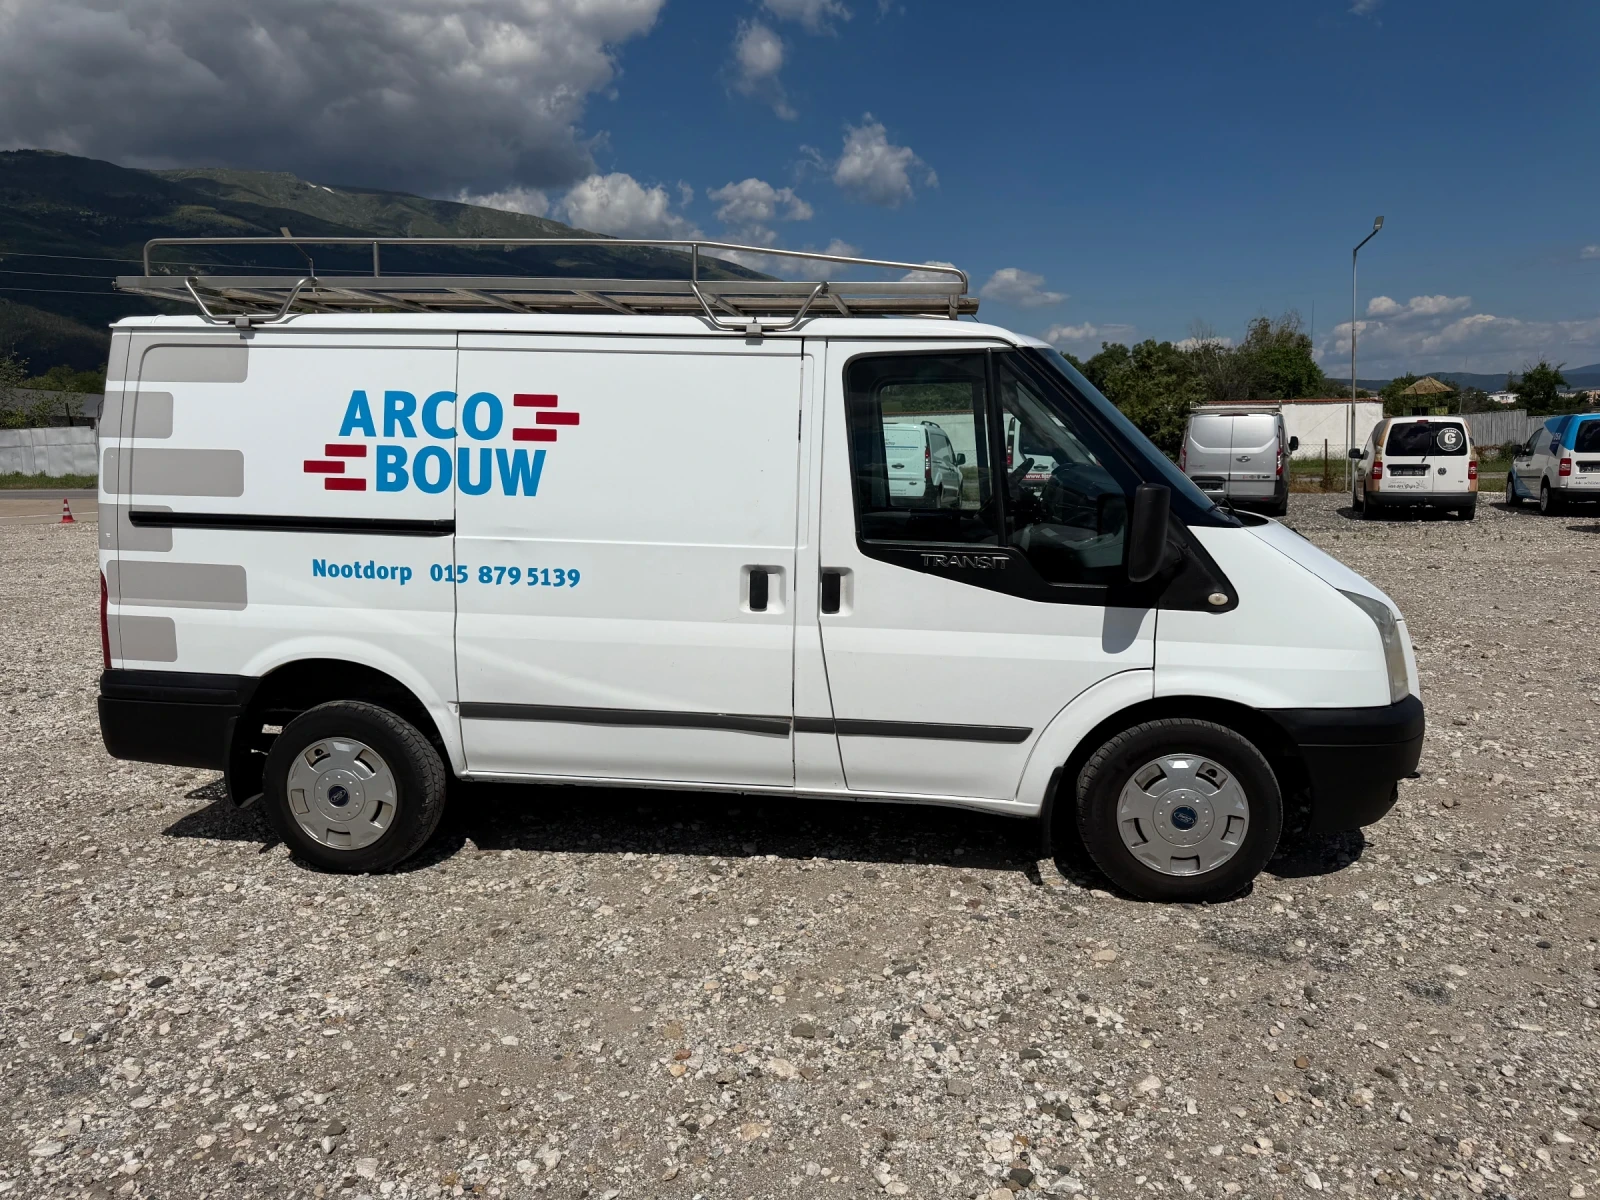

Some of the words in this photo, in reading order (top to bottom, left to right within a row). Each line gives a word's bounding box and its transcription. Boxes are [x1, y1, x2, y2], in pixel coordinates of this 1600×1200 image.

[338, 390, 504, 441] ARCO
[1444, 432, 1456, 444] G
[375, 444, 547, 497] BOUW
[312, 559, 413, 586] Nootdorp
[430, 563, 469, 583] 015
[478, 565, 522, 585] 879
[527, 567, 581, 588] 5139
[920, 553, 1010, 570] TRANSIT
